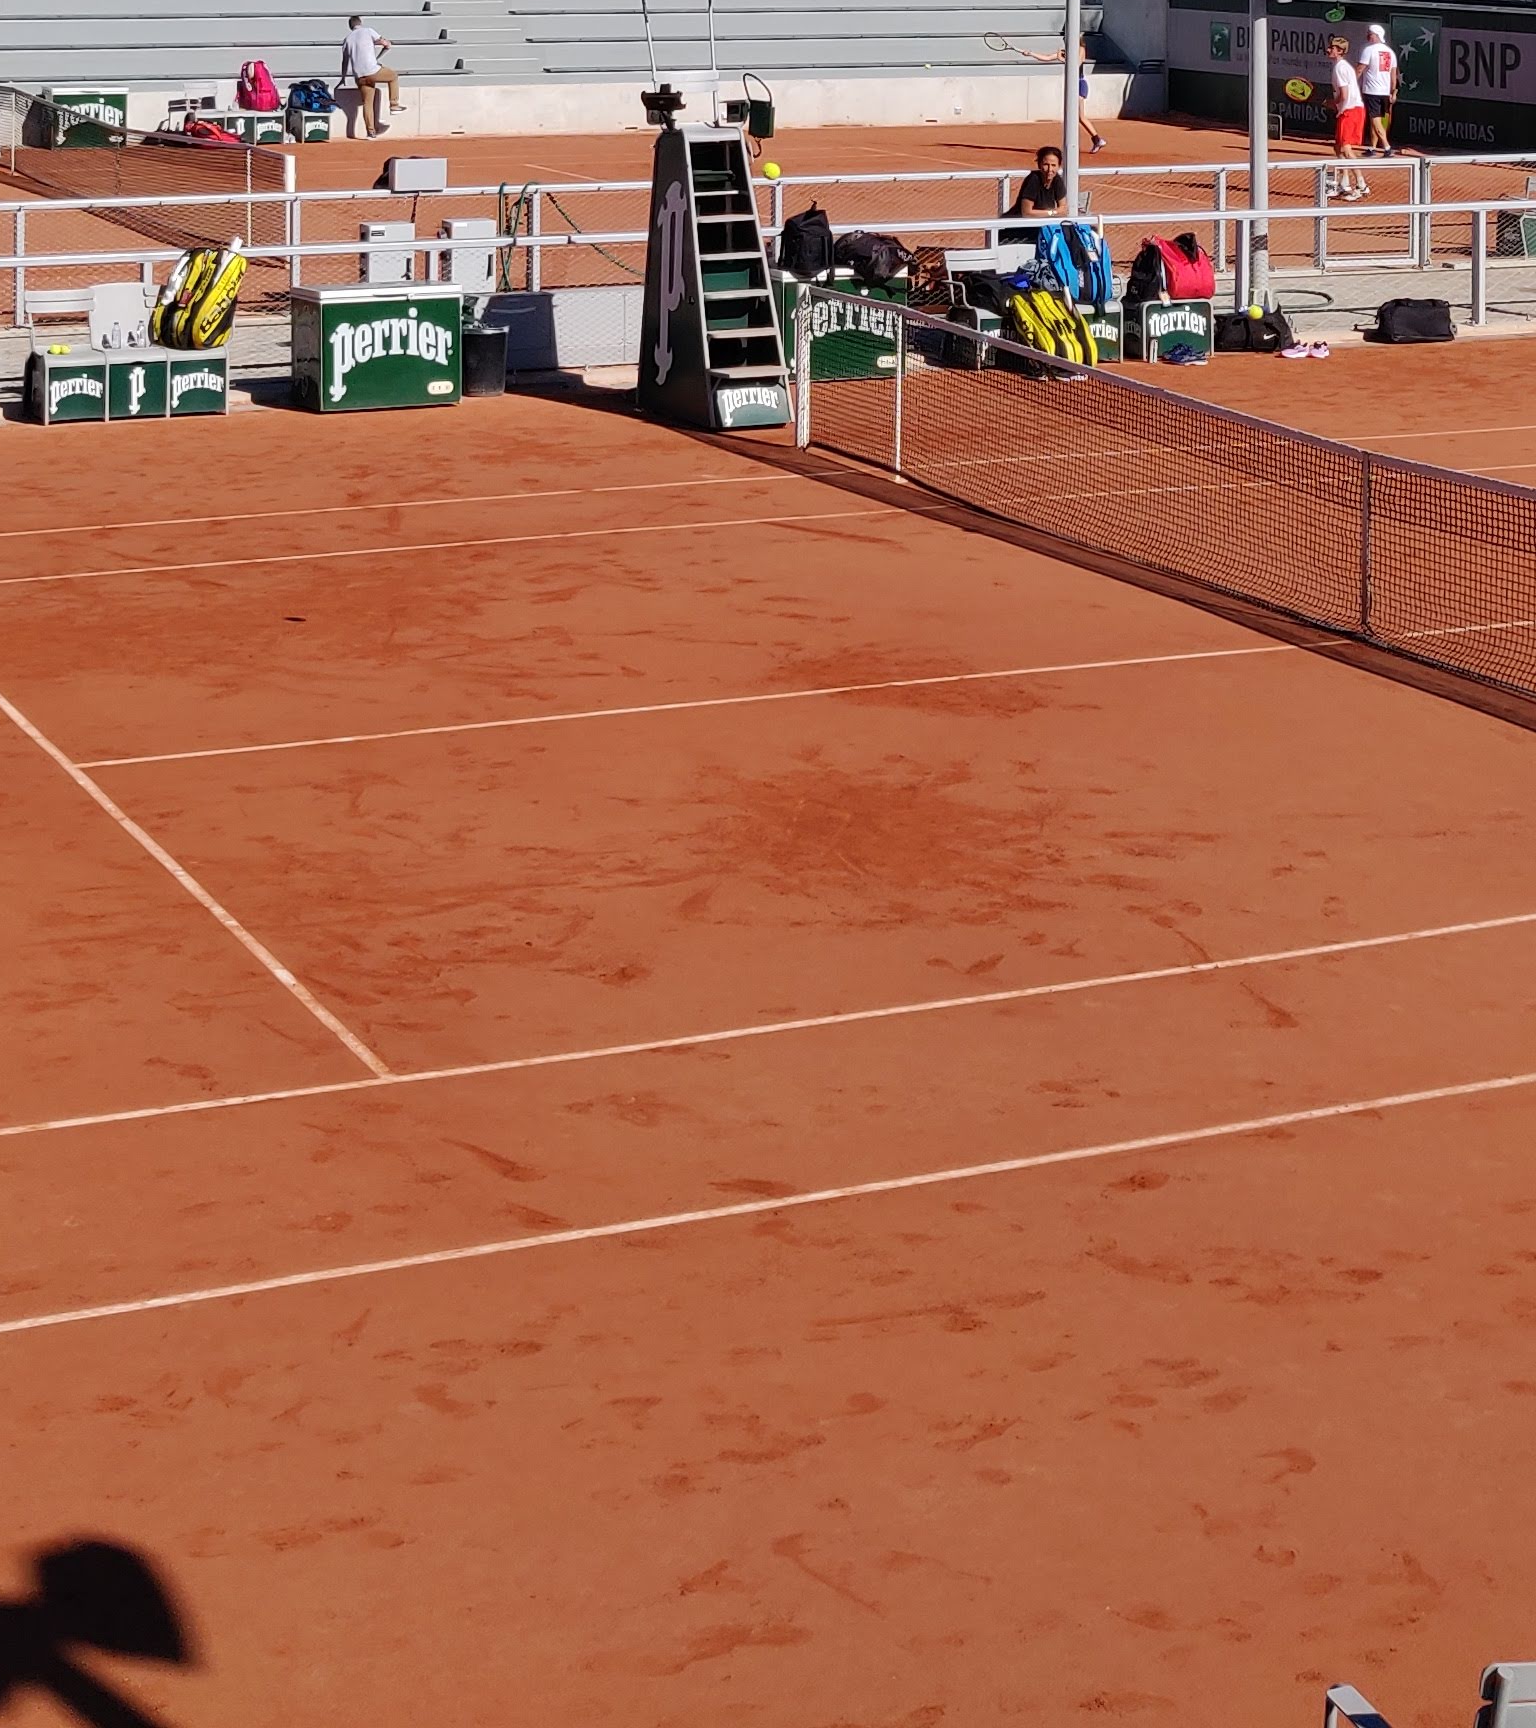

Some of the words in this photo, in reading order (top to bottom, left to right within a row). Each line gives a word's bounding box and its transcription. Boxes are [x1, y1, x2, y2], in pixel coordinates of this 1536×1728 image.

[1449, 39, 1522, 90] BNP
[1409, 116, 1436, 137] BNP
[1438, 120, 1495, 143] PARIBAS
[329, 307, 453, 402] perrier
[49, 373, 103, 415] perrier
[170, 368, 225, 408] perrier
[721, 382, 779, 427] perrier
